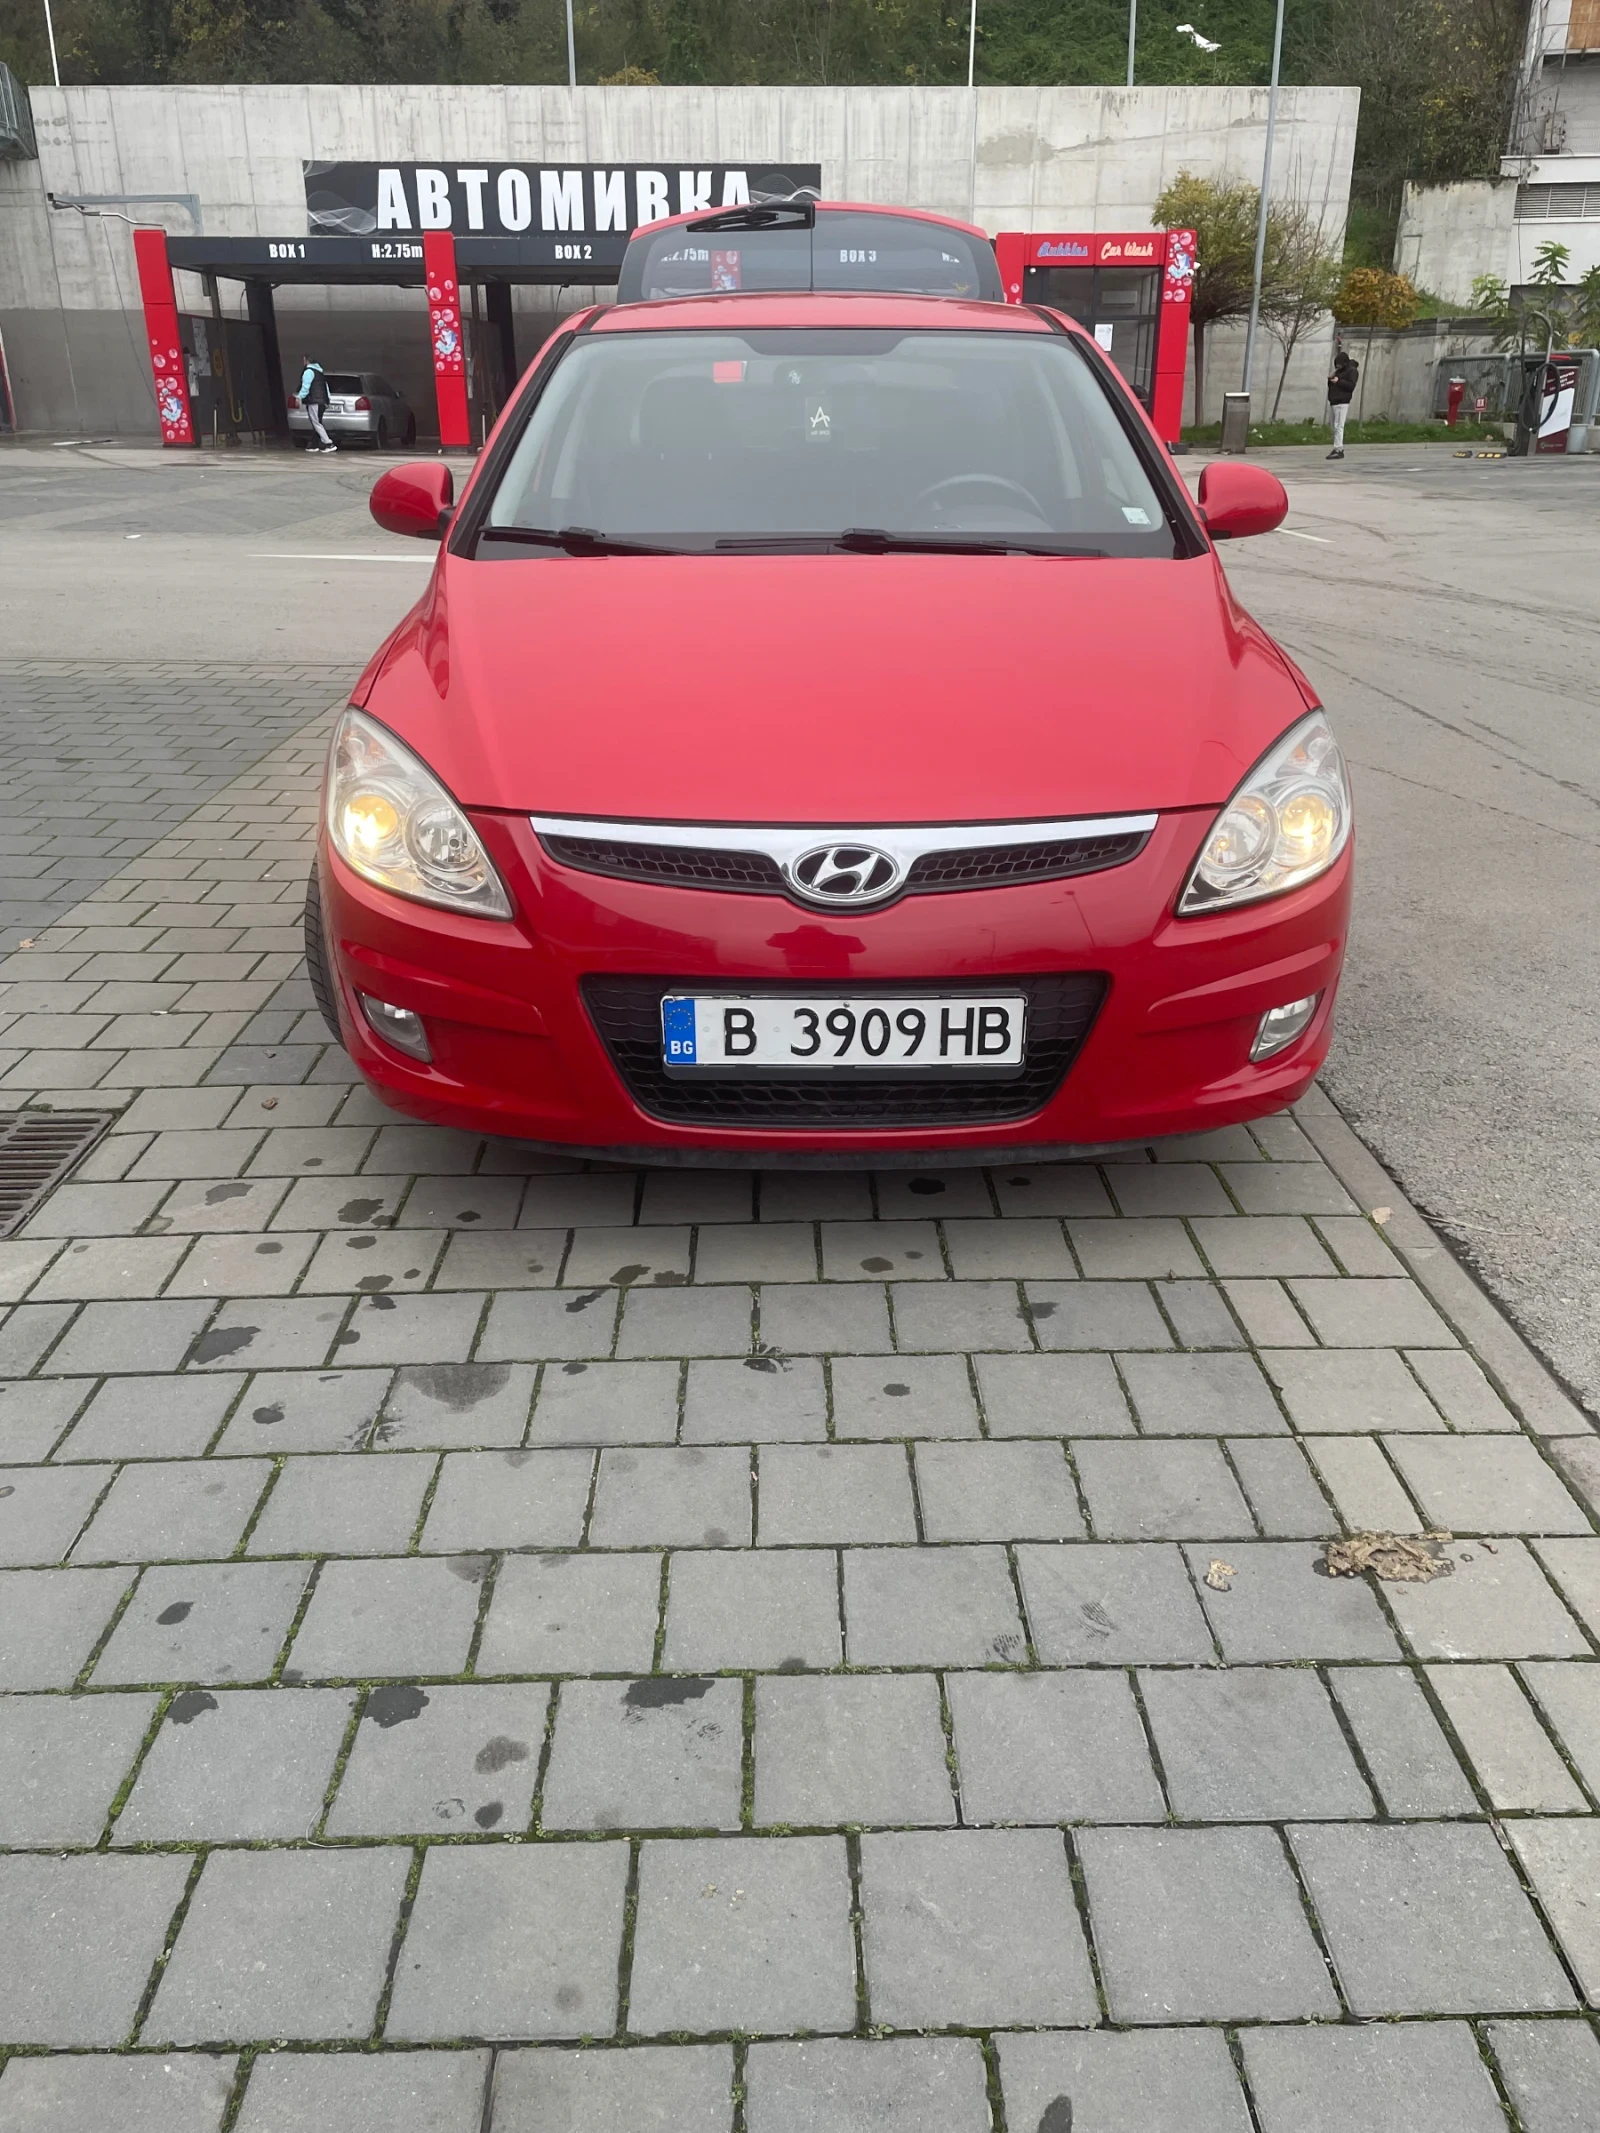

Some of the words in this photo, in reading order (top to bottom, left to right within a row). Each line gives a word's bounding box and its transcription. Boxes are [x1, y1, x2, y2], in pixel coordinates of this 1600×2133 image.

[377, 168, 752, 232] АВТОМИВКА
[269, 244, 296, 258] BOX
[297, 244, 306, 258] 1
[372, 244, 423, 259] H:2.75m
[555, 245, 582, 260] BOX
[583, 245, 593, 260] 2
[840, 249, 868, 263] BOX
[868, 249, 877, 263] 3
[1037, 242, 1089, 258] Bubbles
[1101, 241, 1122, 260] Car
[1124, 241, 1153, 257] Wash
[723, 1007, 757, 1057] B
[670, 1040, 694, 1055] BG
